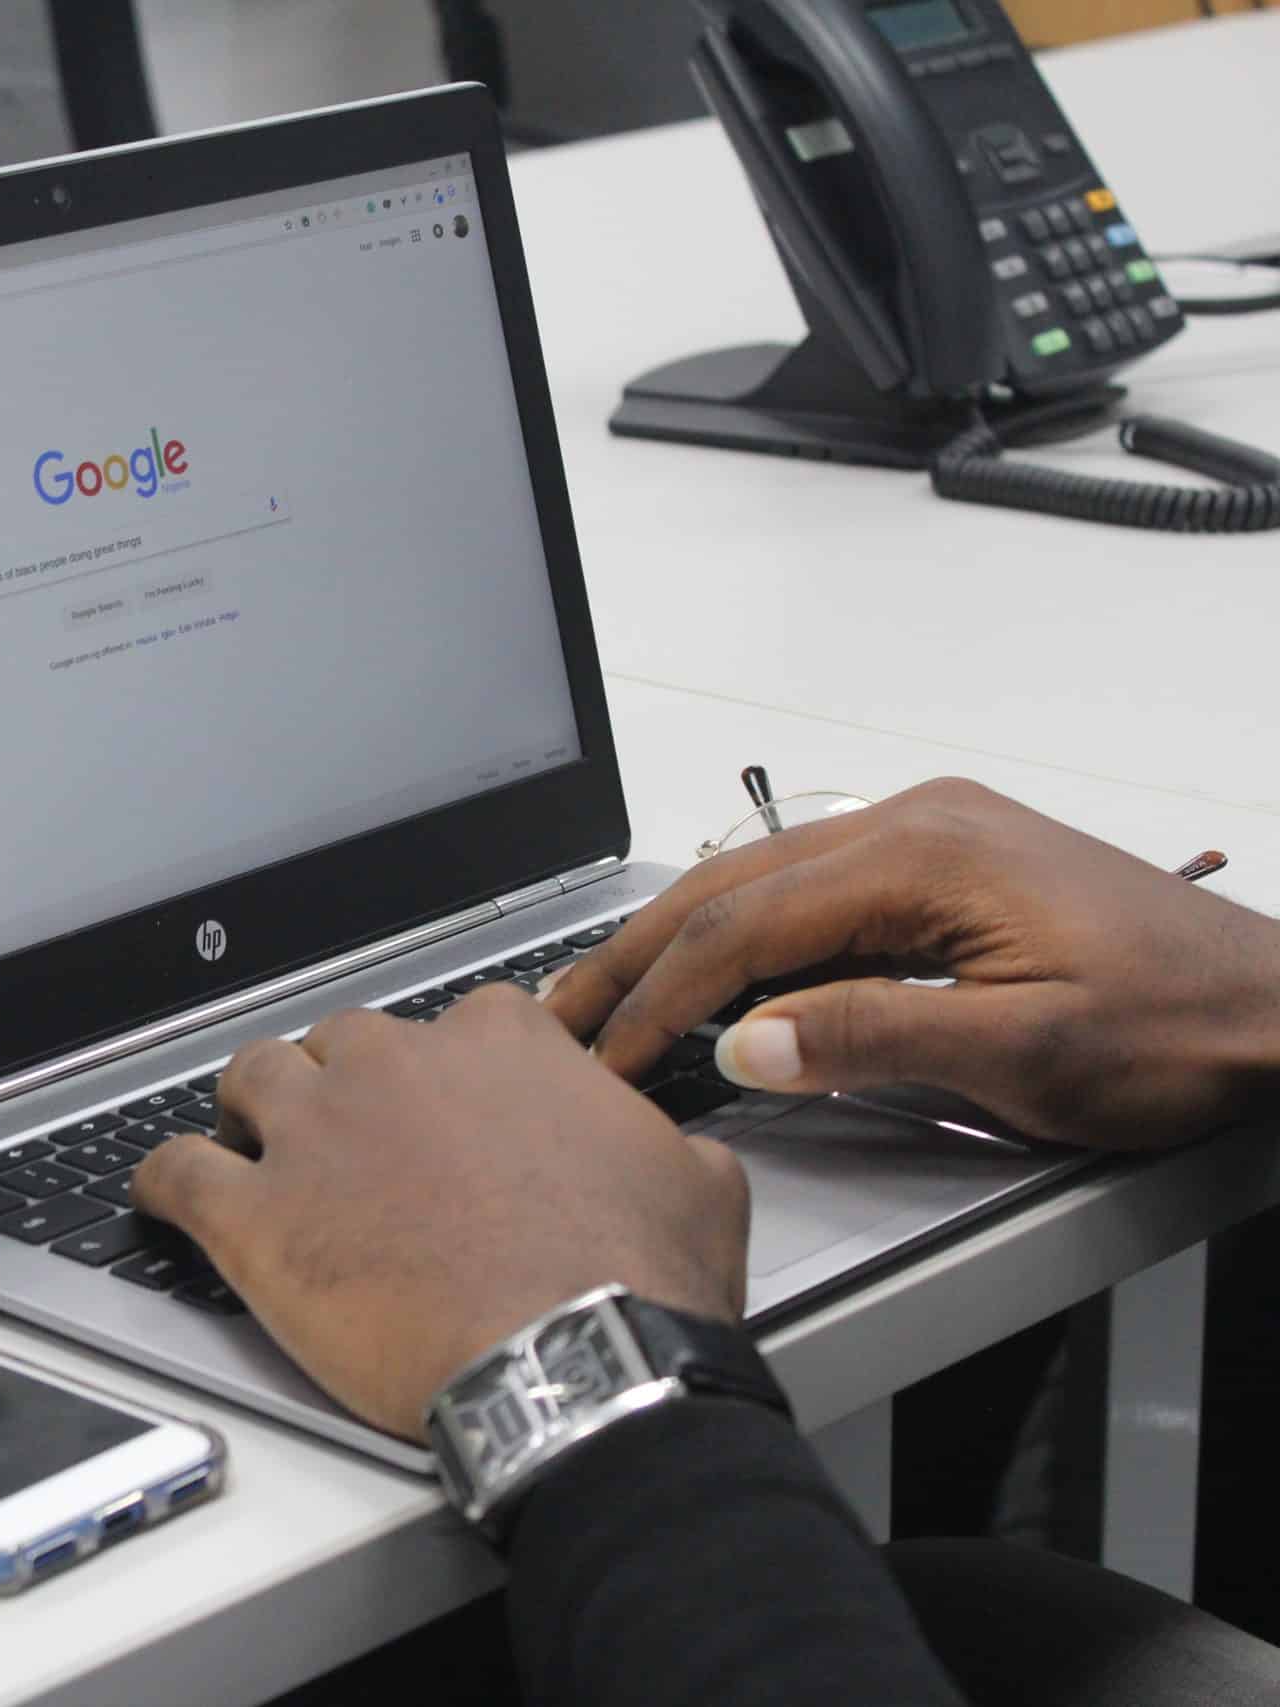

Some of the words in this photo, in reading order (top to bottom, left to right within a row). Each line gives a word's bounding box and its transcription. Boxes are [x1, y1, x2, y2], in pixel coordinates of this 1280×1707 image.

[33, 426, 188, 505] Google
[4, 568, 14, 581] of
[14, 564, 37, 578] black
[39, 555, 68, 574] people
[69, 548, 93, 564] doing
[94, 542, 116, 559] great
[117, 535, 142, 551] things
